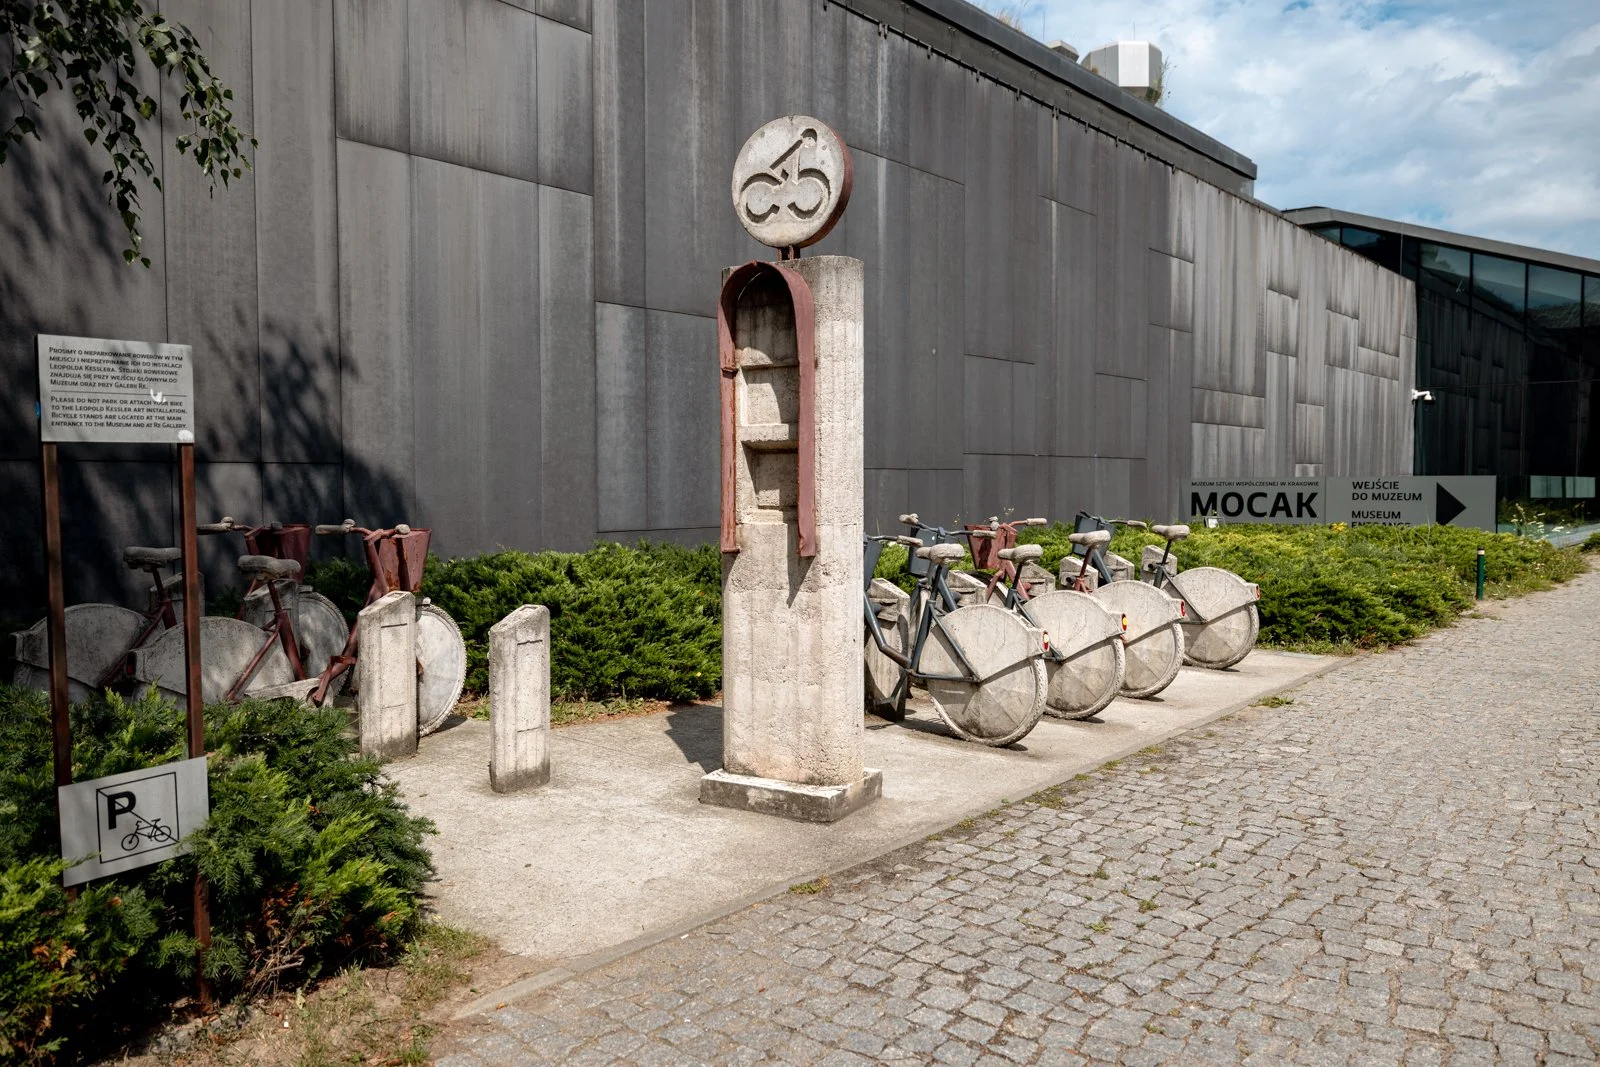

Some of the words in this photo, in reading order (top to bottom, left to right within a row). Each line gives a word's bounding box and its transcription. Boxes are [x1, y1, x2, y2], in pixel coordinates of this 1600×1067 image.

[84, 350, 131, 358] NIEPARKOWANIE
[118, 366, 143, 374] STOJAKI
[110, 374, 136, 382] WEJŚCIU
[50, 379, 79, 387] MUZEUM
[114, 382, 138, 390] GALERII
[50, 395, 76, 403] PLEASE
[105, 405, 132, 413] KESSLER
[1235, 479, 1279, 487] WSPÓŁCZESNEJ
[1352, 478, 1400, 490] WEJŚCIE
[1351, 492, 1368, 501] DO
[1371, 492, 1422, 501] MUZEUM
[1191, 491, 1319, 518] MOCAK
[1351, 510, 1401, 519] MUSEUM
[107, 790, 137, 830] P
